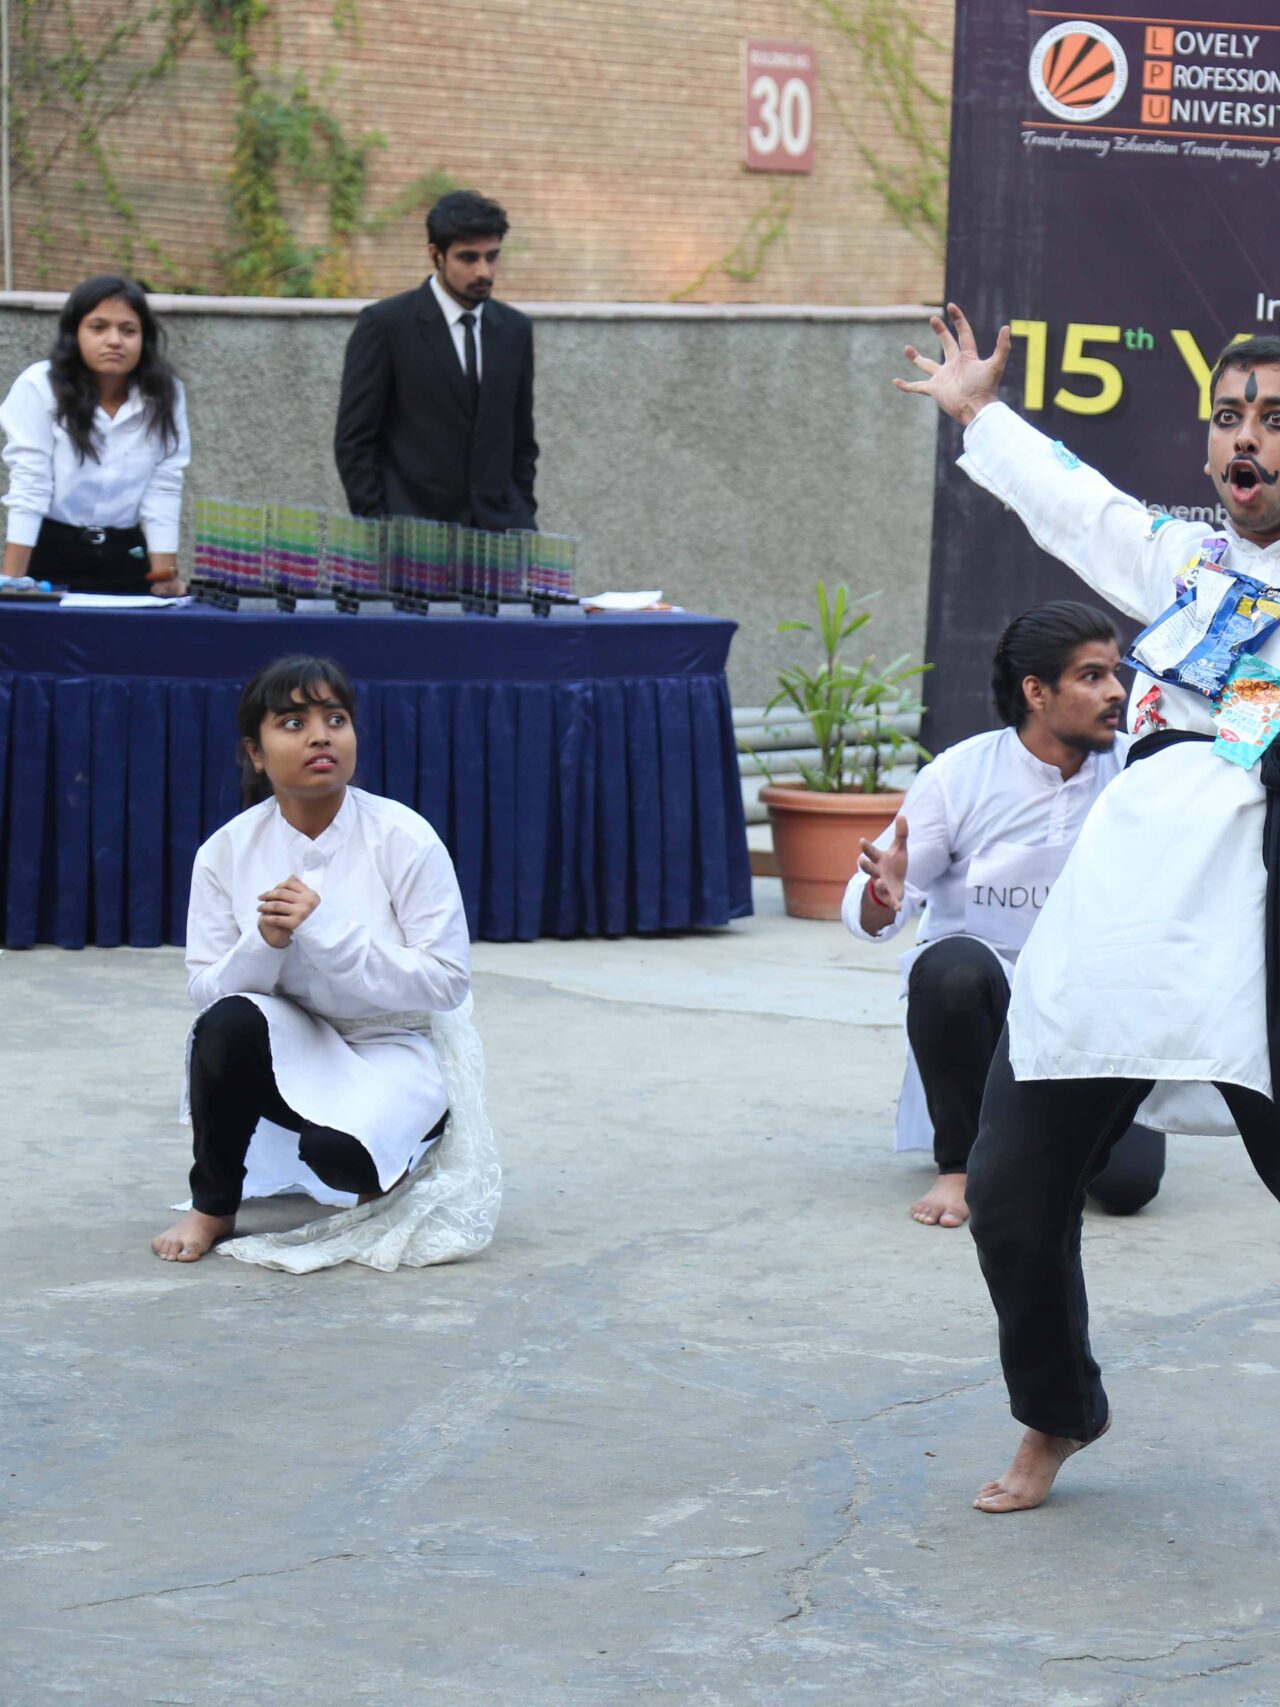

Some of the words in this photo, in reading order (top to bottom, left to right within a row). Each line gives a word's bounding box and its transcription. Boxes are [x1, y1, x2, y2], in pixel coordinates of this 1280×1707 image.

[1151, 28, 1260, 58] LOVELY
[750, 75, 812, 156] 30
[1021, 130, 1110, 158] Transforming
[1113, 134, 1178, 155] Education
[1181, 140, 1270, 168] Transforming
